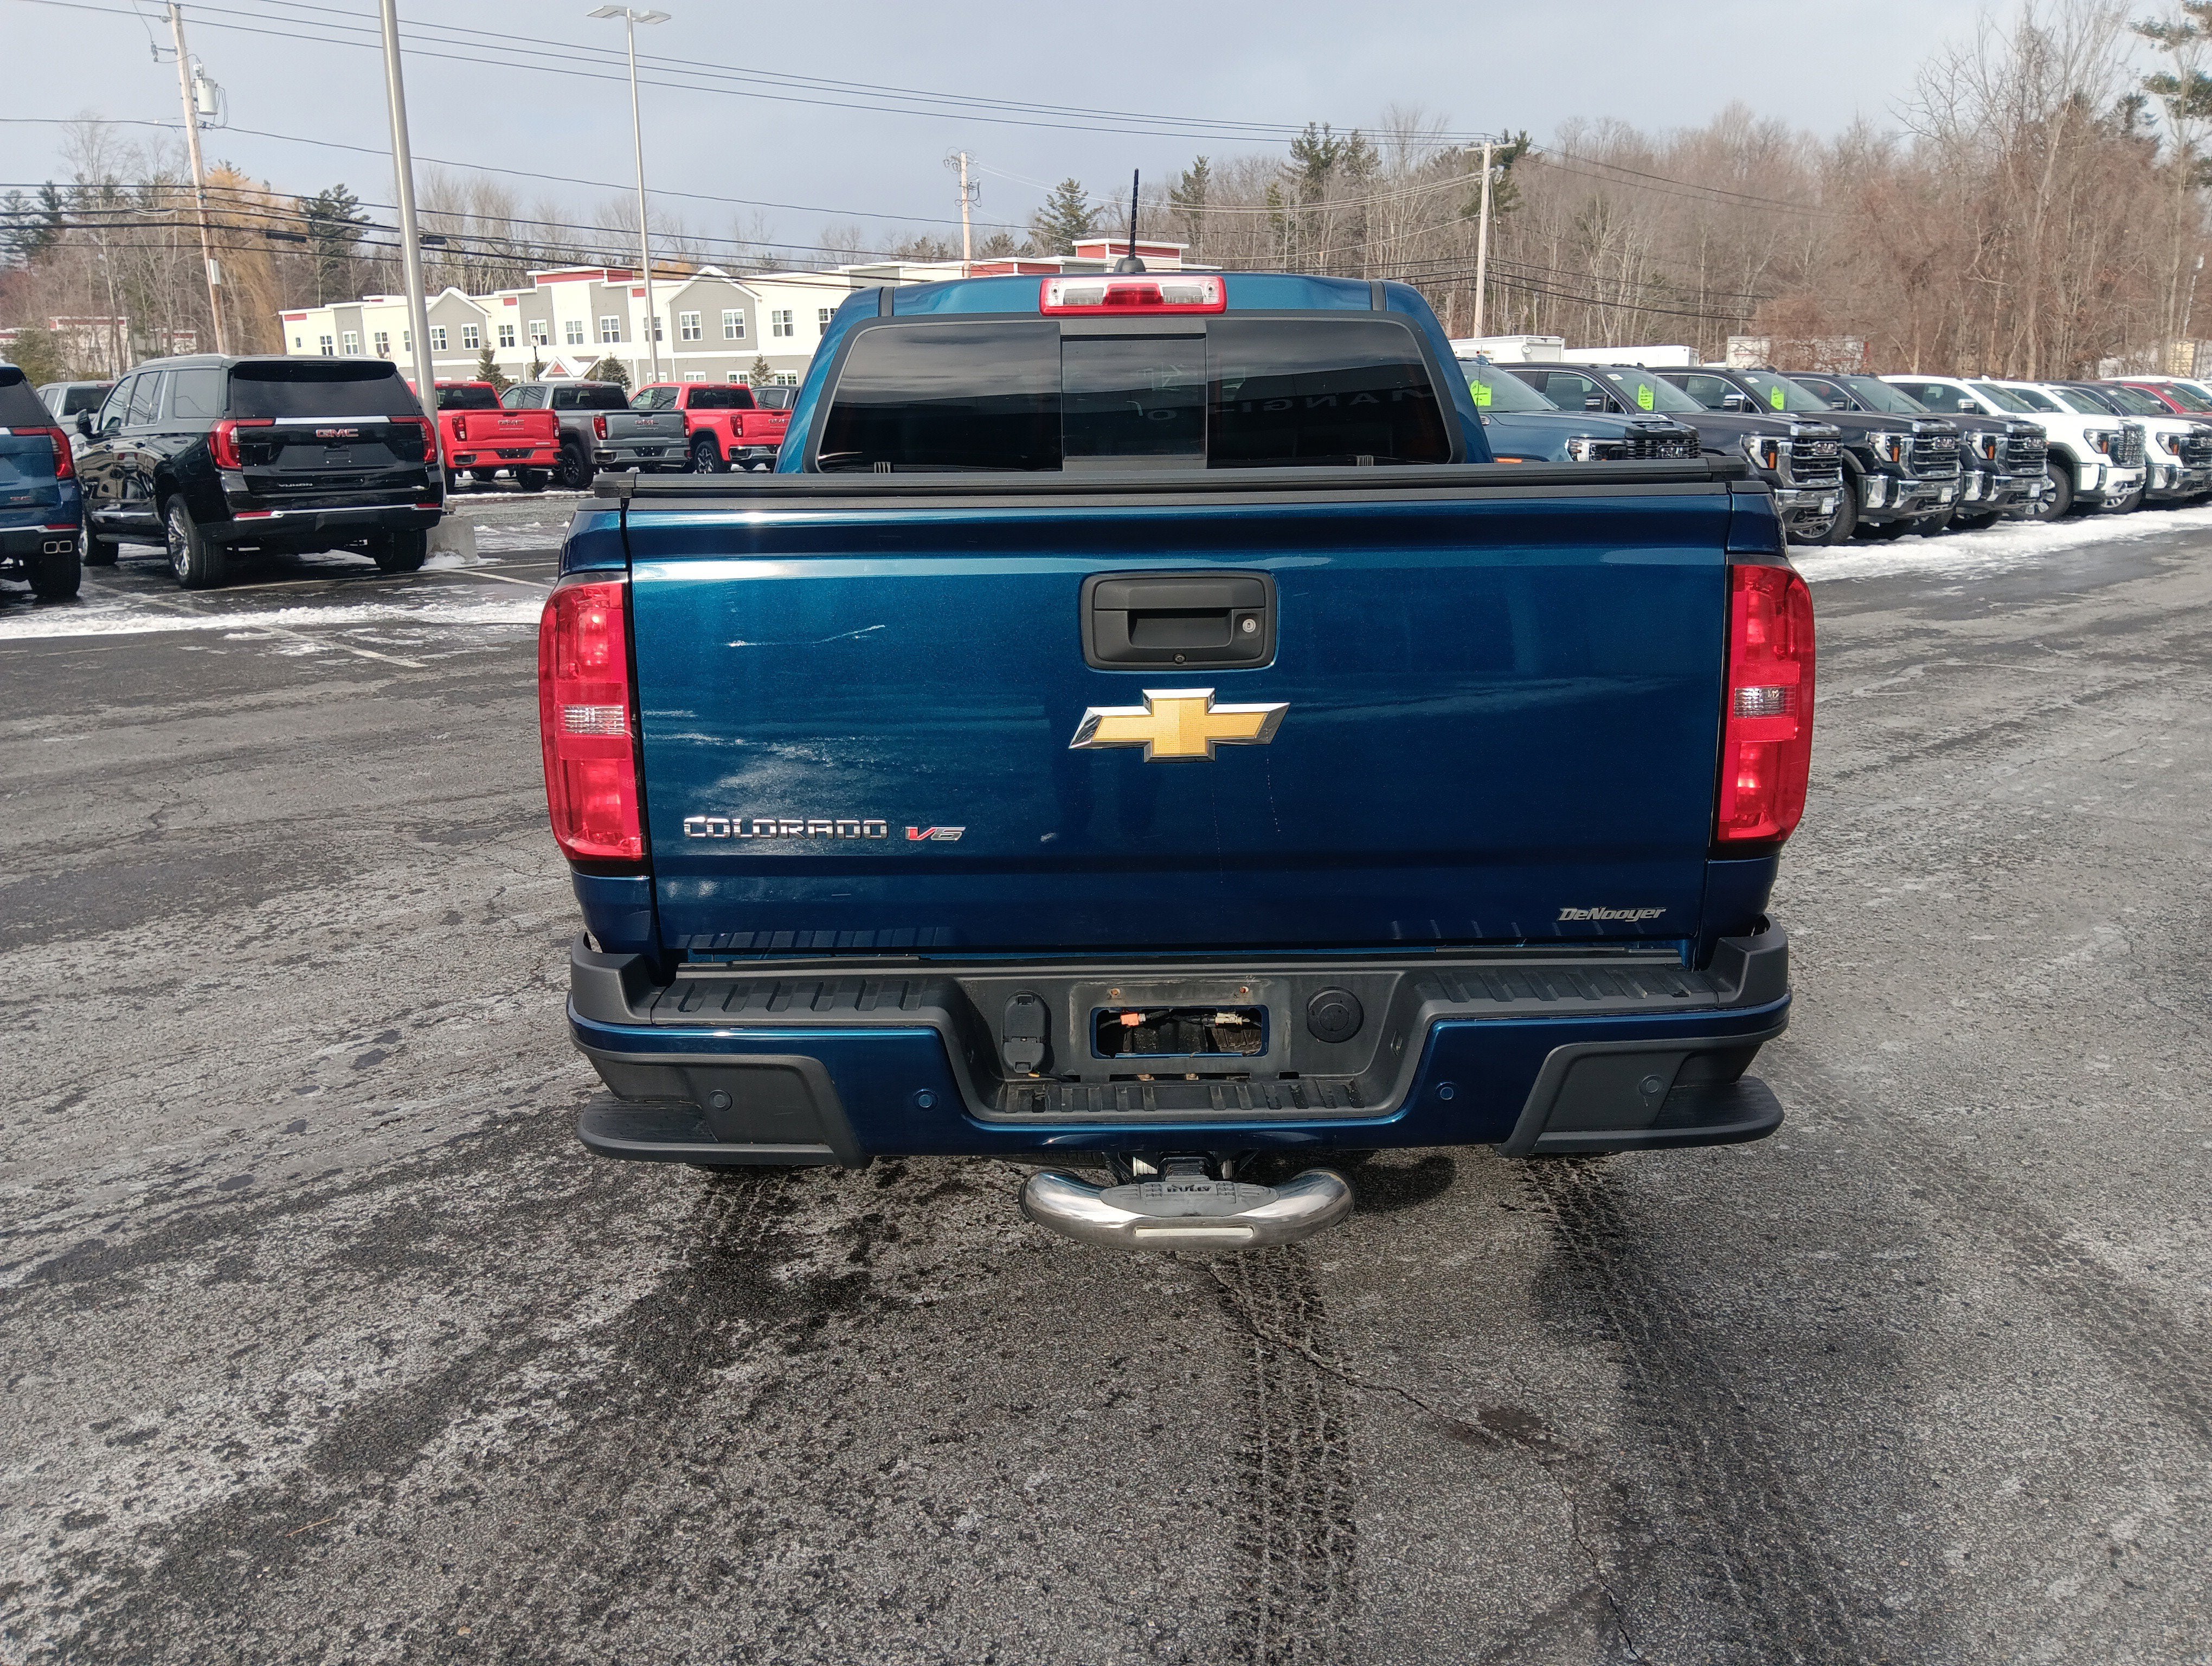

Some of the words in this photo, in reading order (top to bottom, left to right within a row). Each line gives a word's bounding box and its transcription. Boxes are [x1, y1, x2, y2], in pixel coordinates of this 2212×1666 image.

[316, 429, 359, 437] GMC
[684, 816, 889, 840] COLORADO
[905, 825, 966, 841] V6
[1558, 907, 1667, 922] DeNooyer
